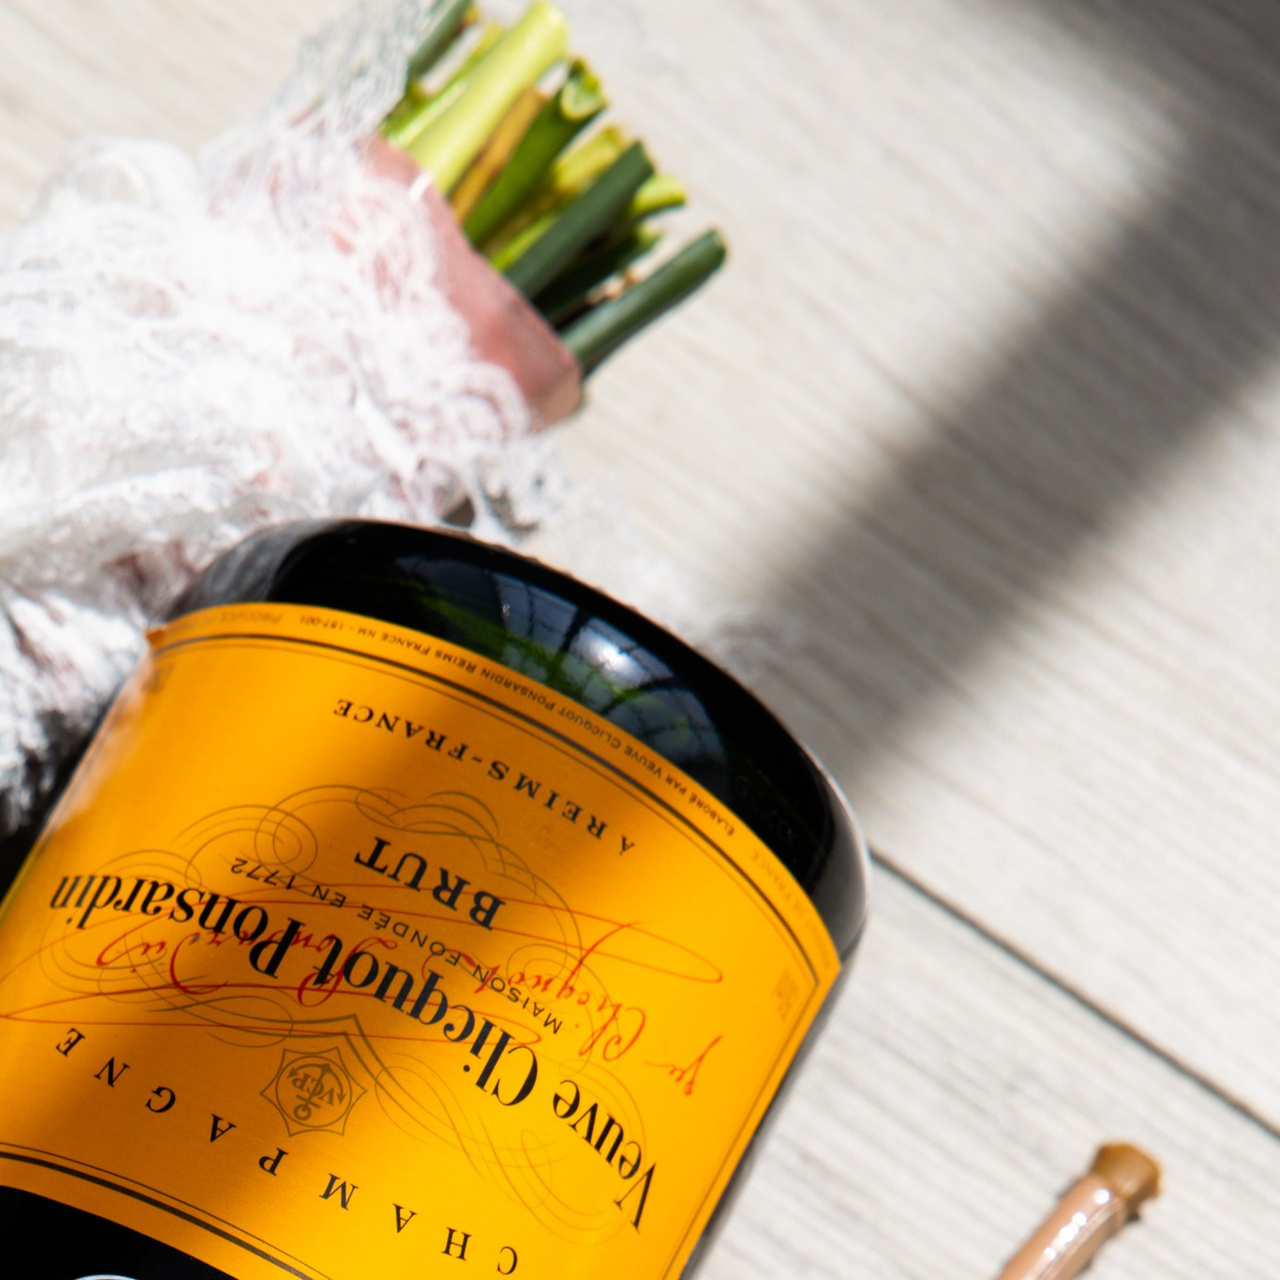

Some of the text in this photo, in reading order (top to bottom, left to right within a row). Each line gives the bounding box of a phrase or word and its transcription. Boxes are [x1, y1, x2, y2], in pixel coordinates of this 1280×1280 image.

[381, 632, 430, 656] FRANCE
[434, 650, 477, 674] REIMS
[481, 666, 556, 712] PONSARDIN
[558, 706, 621, 749] CLICQUOT
[624, 747, 662, 778] VEUVE
[664, 775, 687, 797] PAR
[619, 834, 635, 856] À
[230, 858, 296, 891] 1772
[354, 836, 506, 931] BRUT
[311, 884, 347, 909] EN
[49, 874, 306, 980] Ponsardin
[312, 934, 538, 1107] Clicquot
[291, 1072, 335, 1107] VCP
[55, 1027, 519, 1276] CHAMPAGNE
[552, 1079, 656, 1233] Veuve
